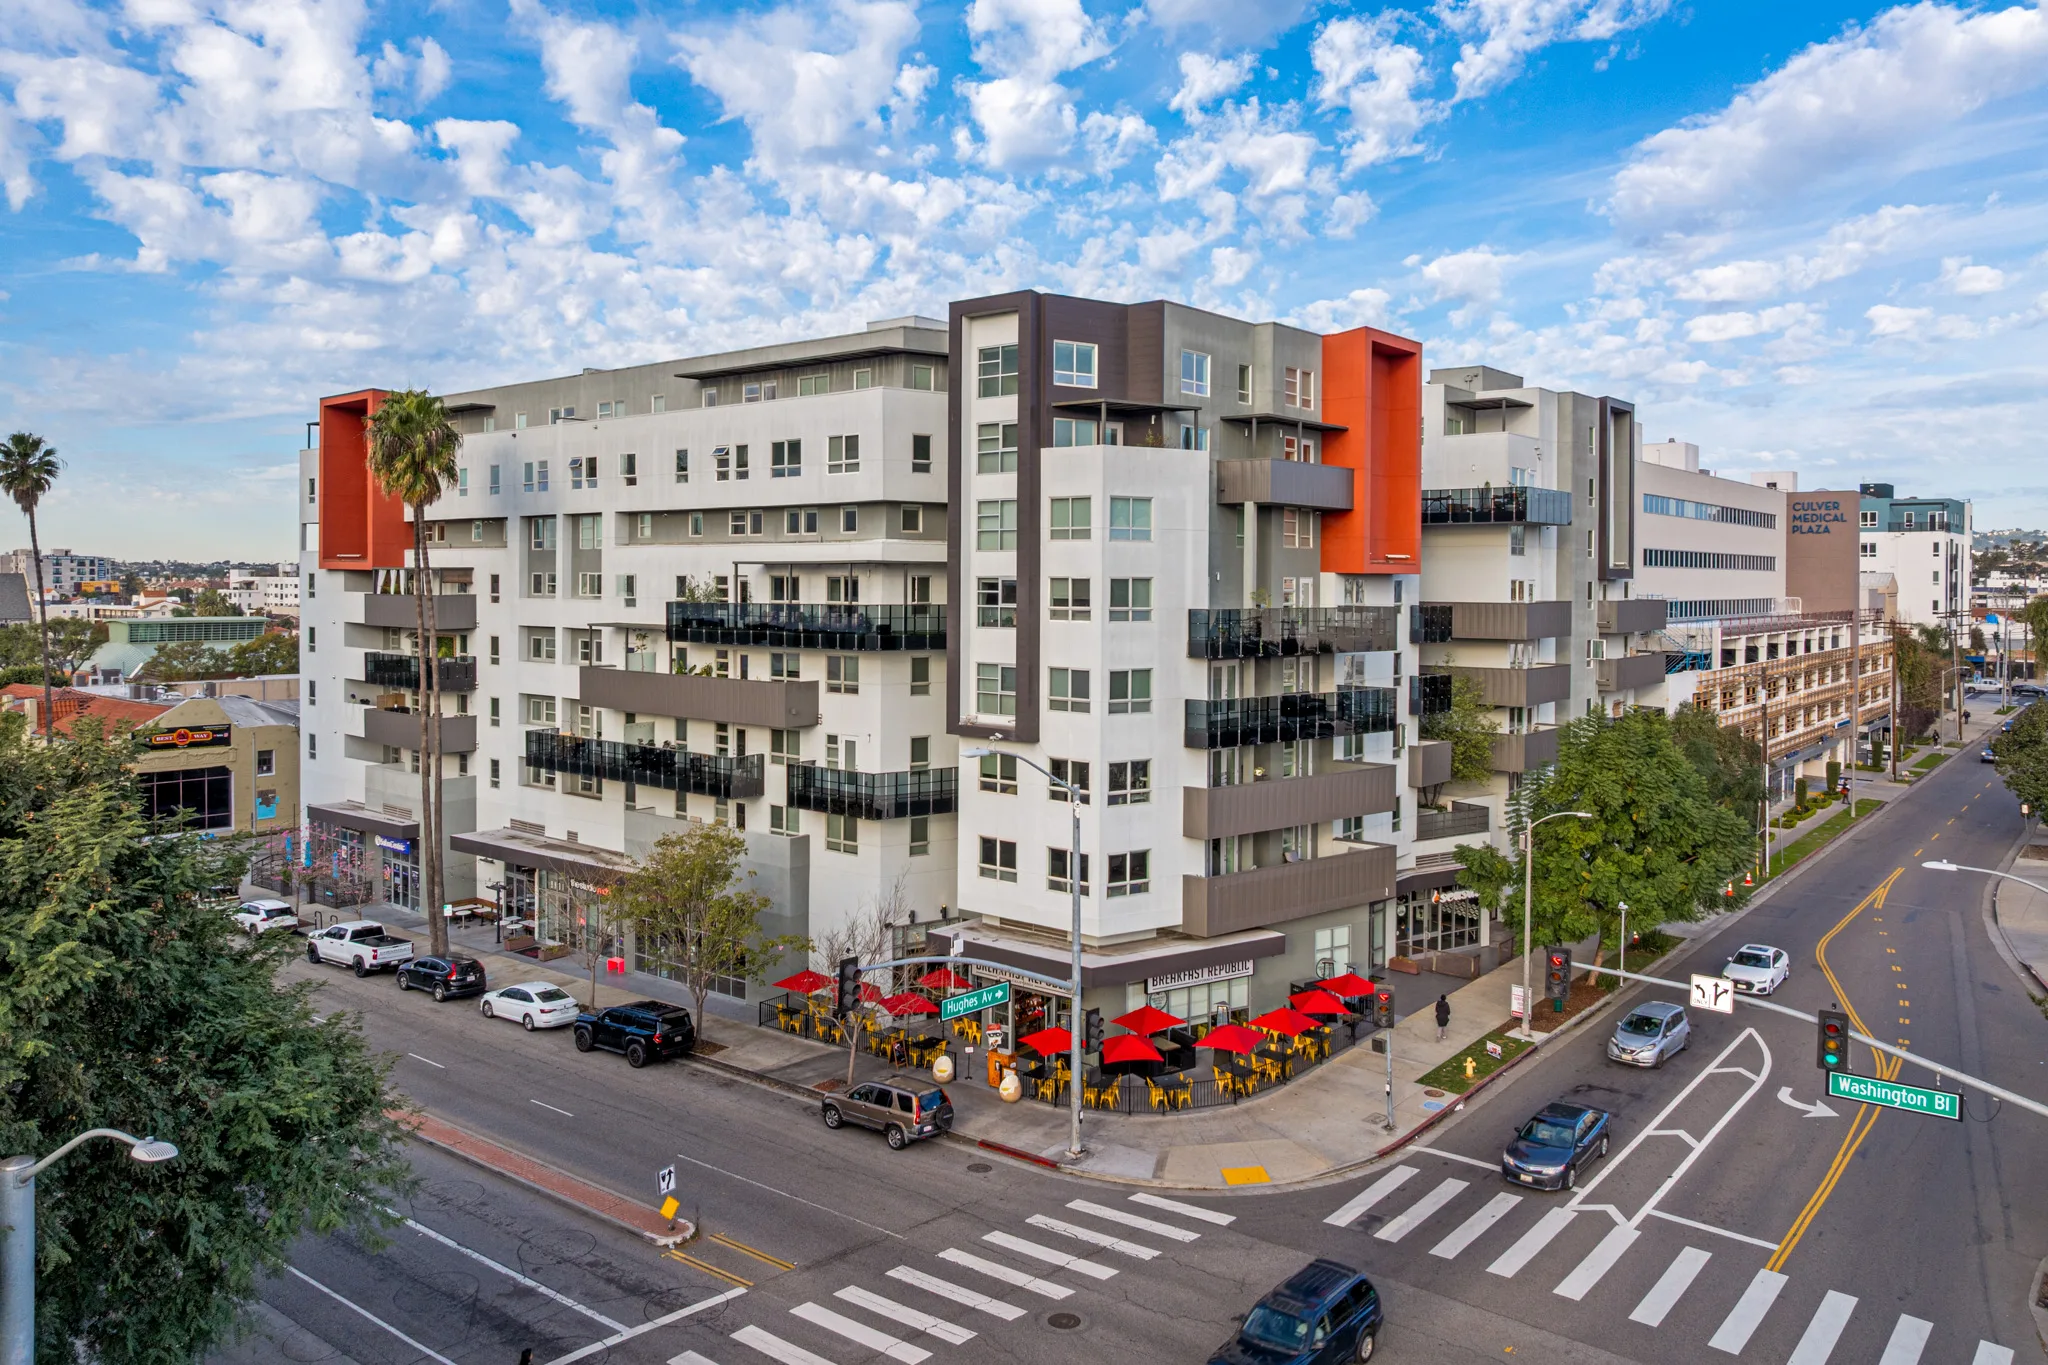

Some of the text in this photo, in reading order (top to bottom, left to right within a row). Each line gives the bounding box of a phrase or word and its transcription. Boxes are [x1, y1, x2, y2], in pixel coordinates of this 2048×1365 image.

[1792, 501, 1840, 511] CULVER
[1792, 513, 1847, 523] MEDICAL
[1792, 525, 1831, 534] PLAZA
[1152, 960, 1250, 987] BREAKFAST REPUBLIC
[947, 991, 993, 1014] Hughes Av
[1838, 1076, 1950, 1112] Washington Bl
